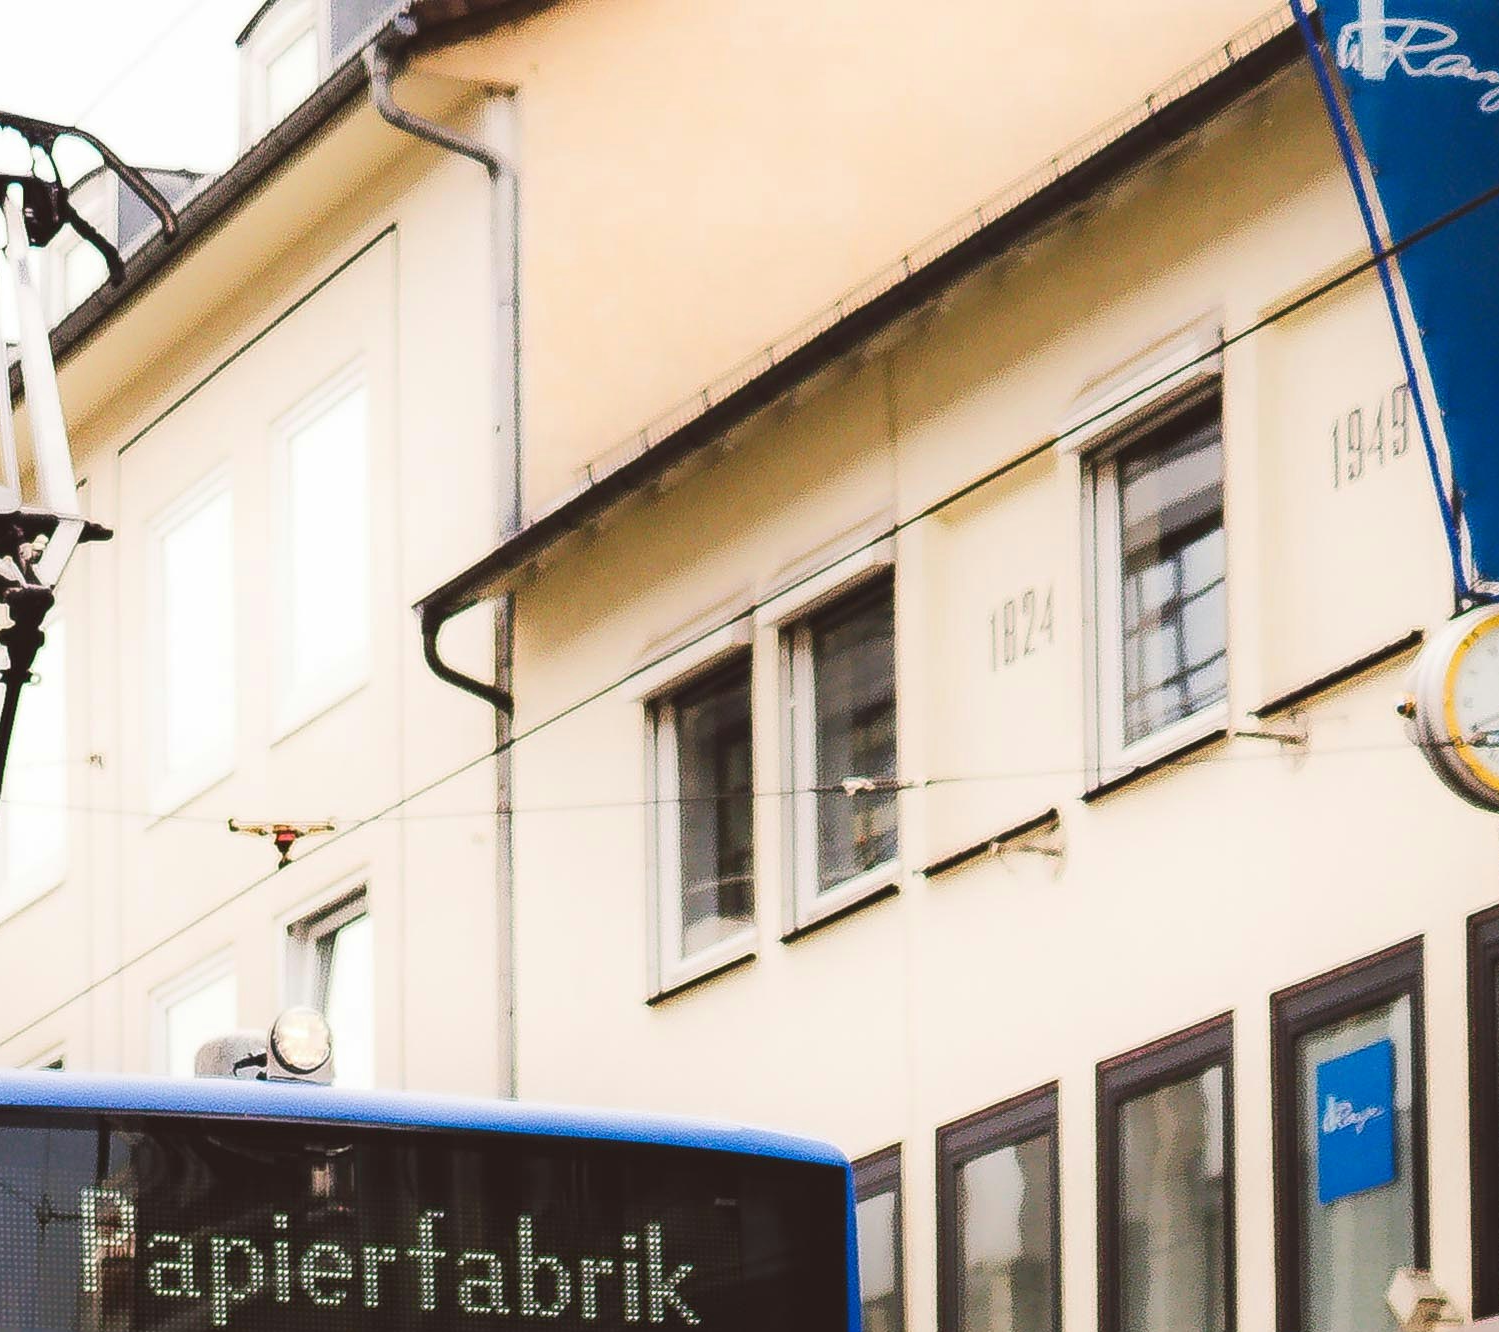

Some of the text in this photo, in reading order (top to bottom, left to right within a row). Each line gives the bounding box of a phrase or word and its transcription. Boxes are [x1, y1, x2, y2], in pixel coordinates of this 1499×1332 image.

[1330, 383, 1409, 490] 1949
[988, 584, 1056, 672] 1824
[80, 1185, 702, 1327] Papierfabrik
